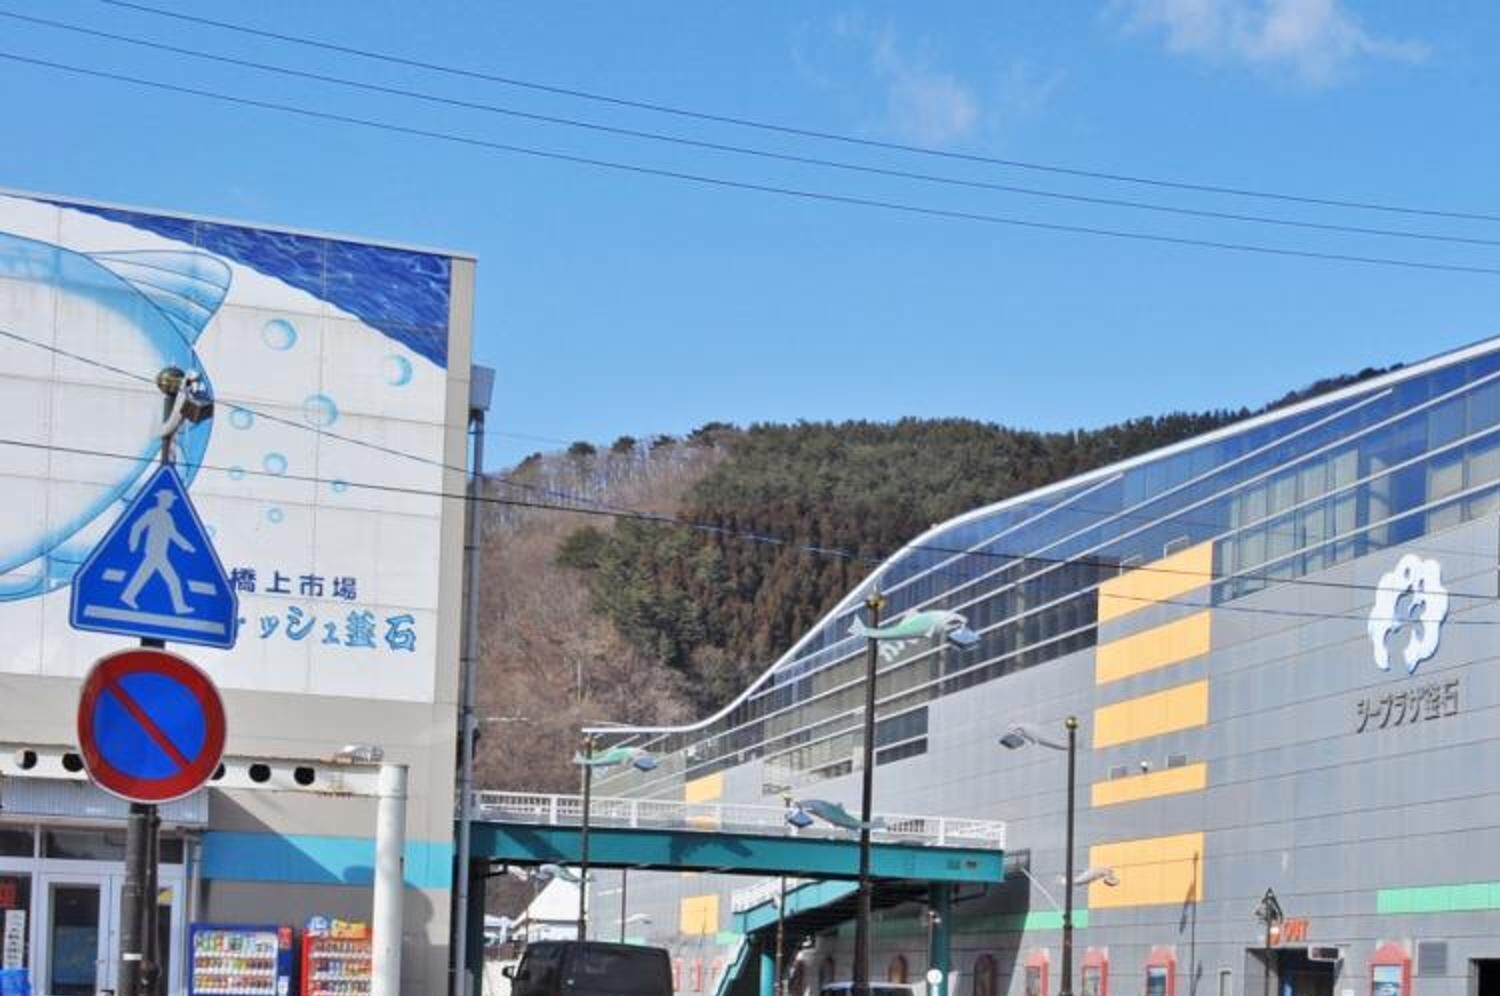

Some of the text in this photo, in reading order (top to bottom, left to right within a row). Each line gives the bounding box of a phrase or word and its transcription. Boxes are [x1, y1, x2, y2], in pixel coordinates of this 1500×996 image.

[230, 567, 358, 601] 橋上市場
[239, 605, 417, 653] ッシュ釜石
